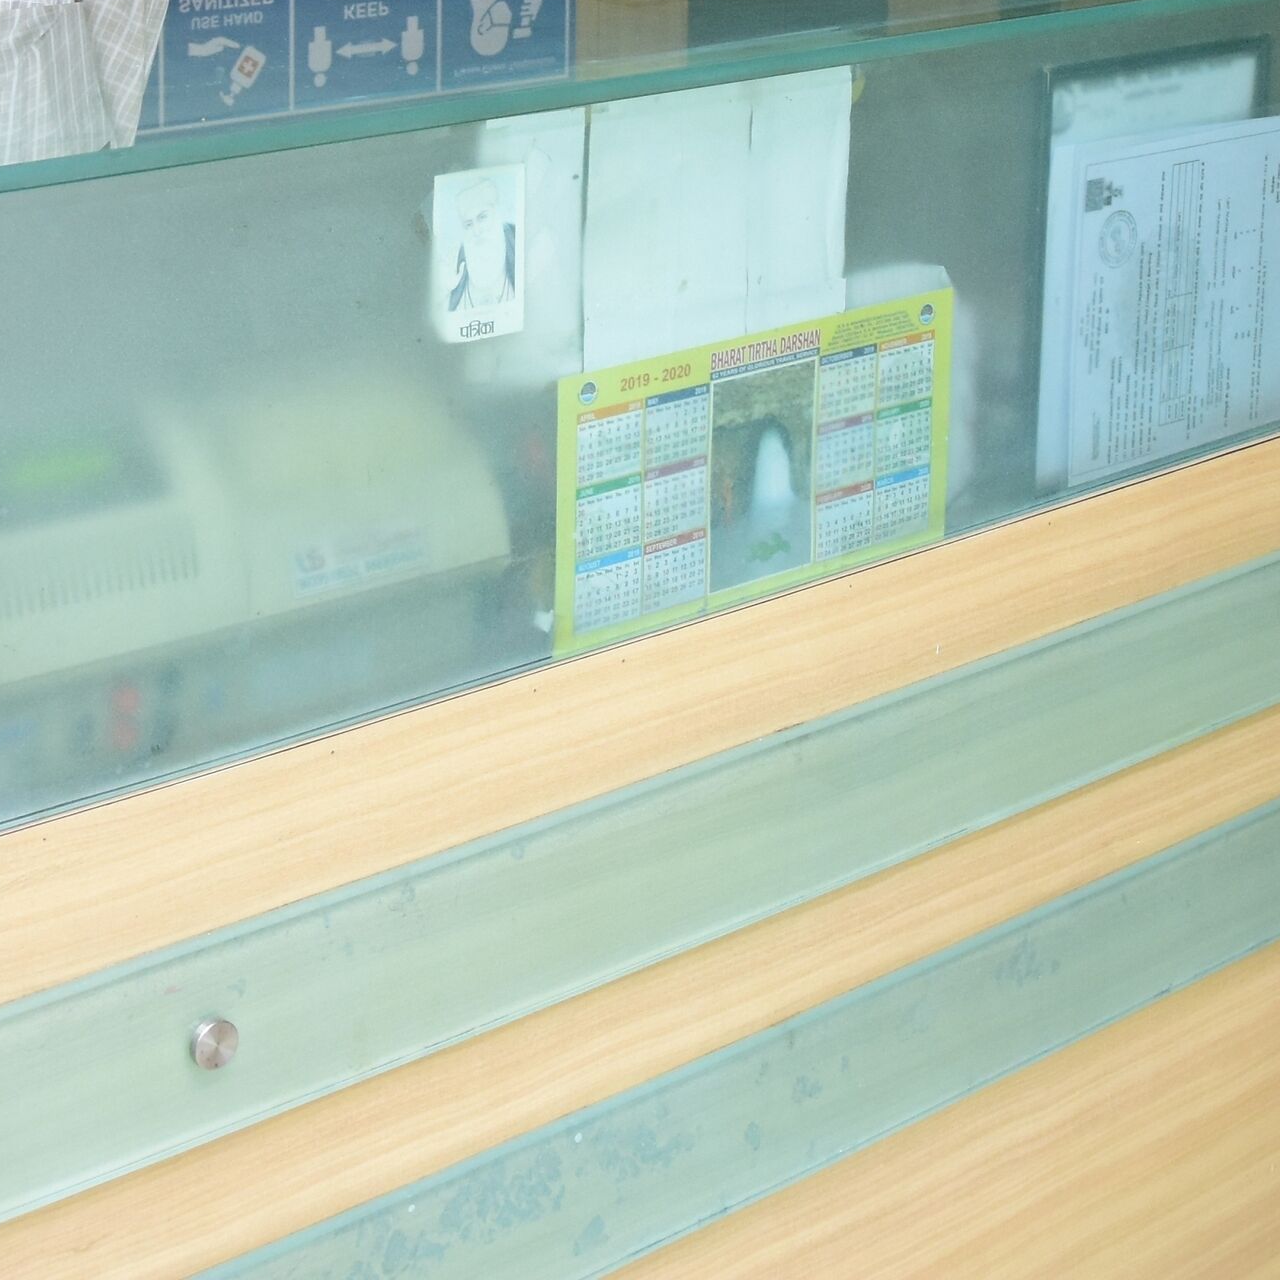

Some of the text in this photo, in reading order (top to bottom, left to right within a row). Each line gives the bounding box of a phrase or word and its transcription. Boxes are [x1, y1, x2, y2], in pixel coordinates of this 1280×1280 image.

[459, 320, 494, 338] पत्रिका
[711, 346, 746, 370] BHARAT
[748, 338, 778, 362] TIRTHA
[780, 328, 820, 354] DARSHAN
[720, 368, 738, 378] YEARS
[776, 354, 796, 366] TRAVEL
[797, 349, 818, 360] SERVICE
[620, 373, 650, 392] 2019
[662, 364, 691, 382] 2020
[646, 538, 678, 554] SEPTEMBER
